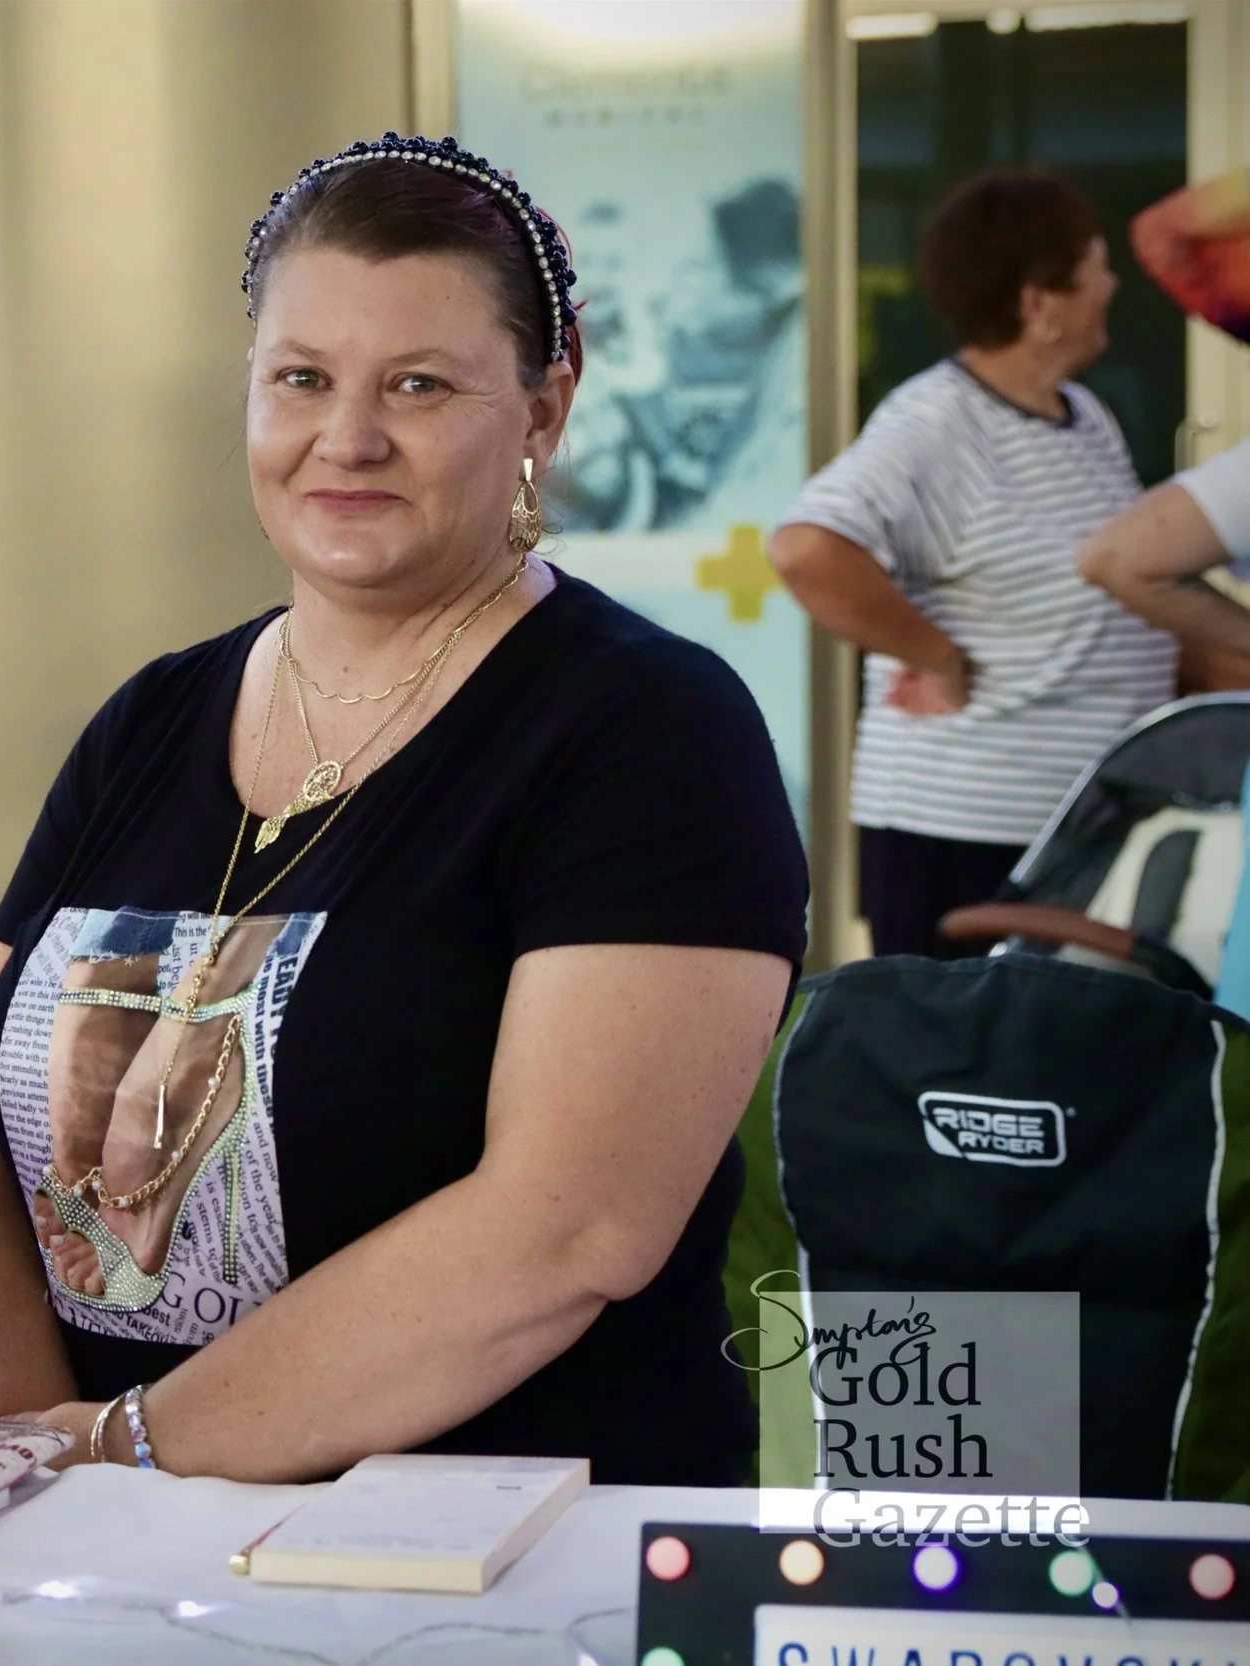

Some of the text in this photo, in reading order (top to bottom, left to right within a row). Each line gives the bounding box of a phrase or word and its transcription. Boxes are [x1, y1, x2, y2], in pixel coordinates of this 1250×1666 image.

[175, 925, 207, 937] This is the
[256, 975, 270, 1017] most
[38, 1004, 55, 1013] earth
[25, 1014, 45, 1026] things
[14, 1041, 30, 1050] away
[32, 1042, 49, 1052] from
[254, 1019, 265, 1061] with
[25, 1054, 40, 1063] with
[11, 1064, 43, 1077] intending
[29, 1080, 49, 1090] much
[1, 1099, 18, 1110] failed
[18, 1102, 37, 1113] badly
[16, 1114, 26, 1123] the
[27, 1116, 42, 1127] edge
[932, 1107, 1045, 1137] RIDGE
[21, 1126, 35, 1138] from
[36, 1130, 44, 1140] all
[958, 1130, 1045, 1154] RYDER
[253, 1122, 278, 1182] and now
[206, 1182, 216, 1194] is
[245, 1150, 277, 1224] of the year
[196, 1202, 213, 1244] stems
